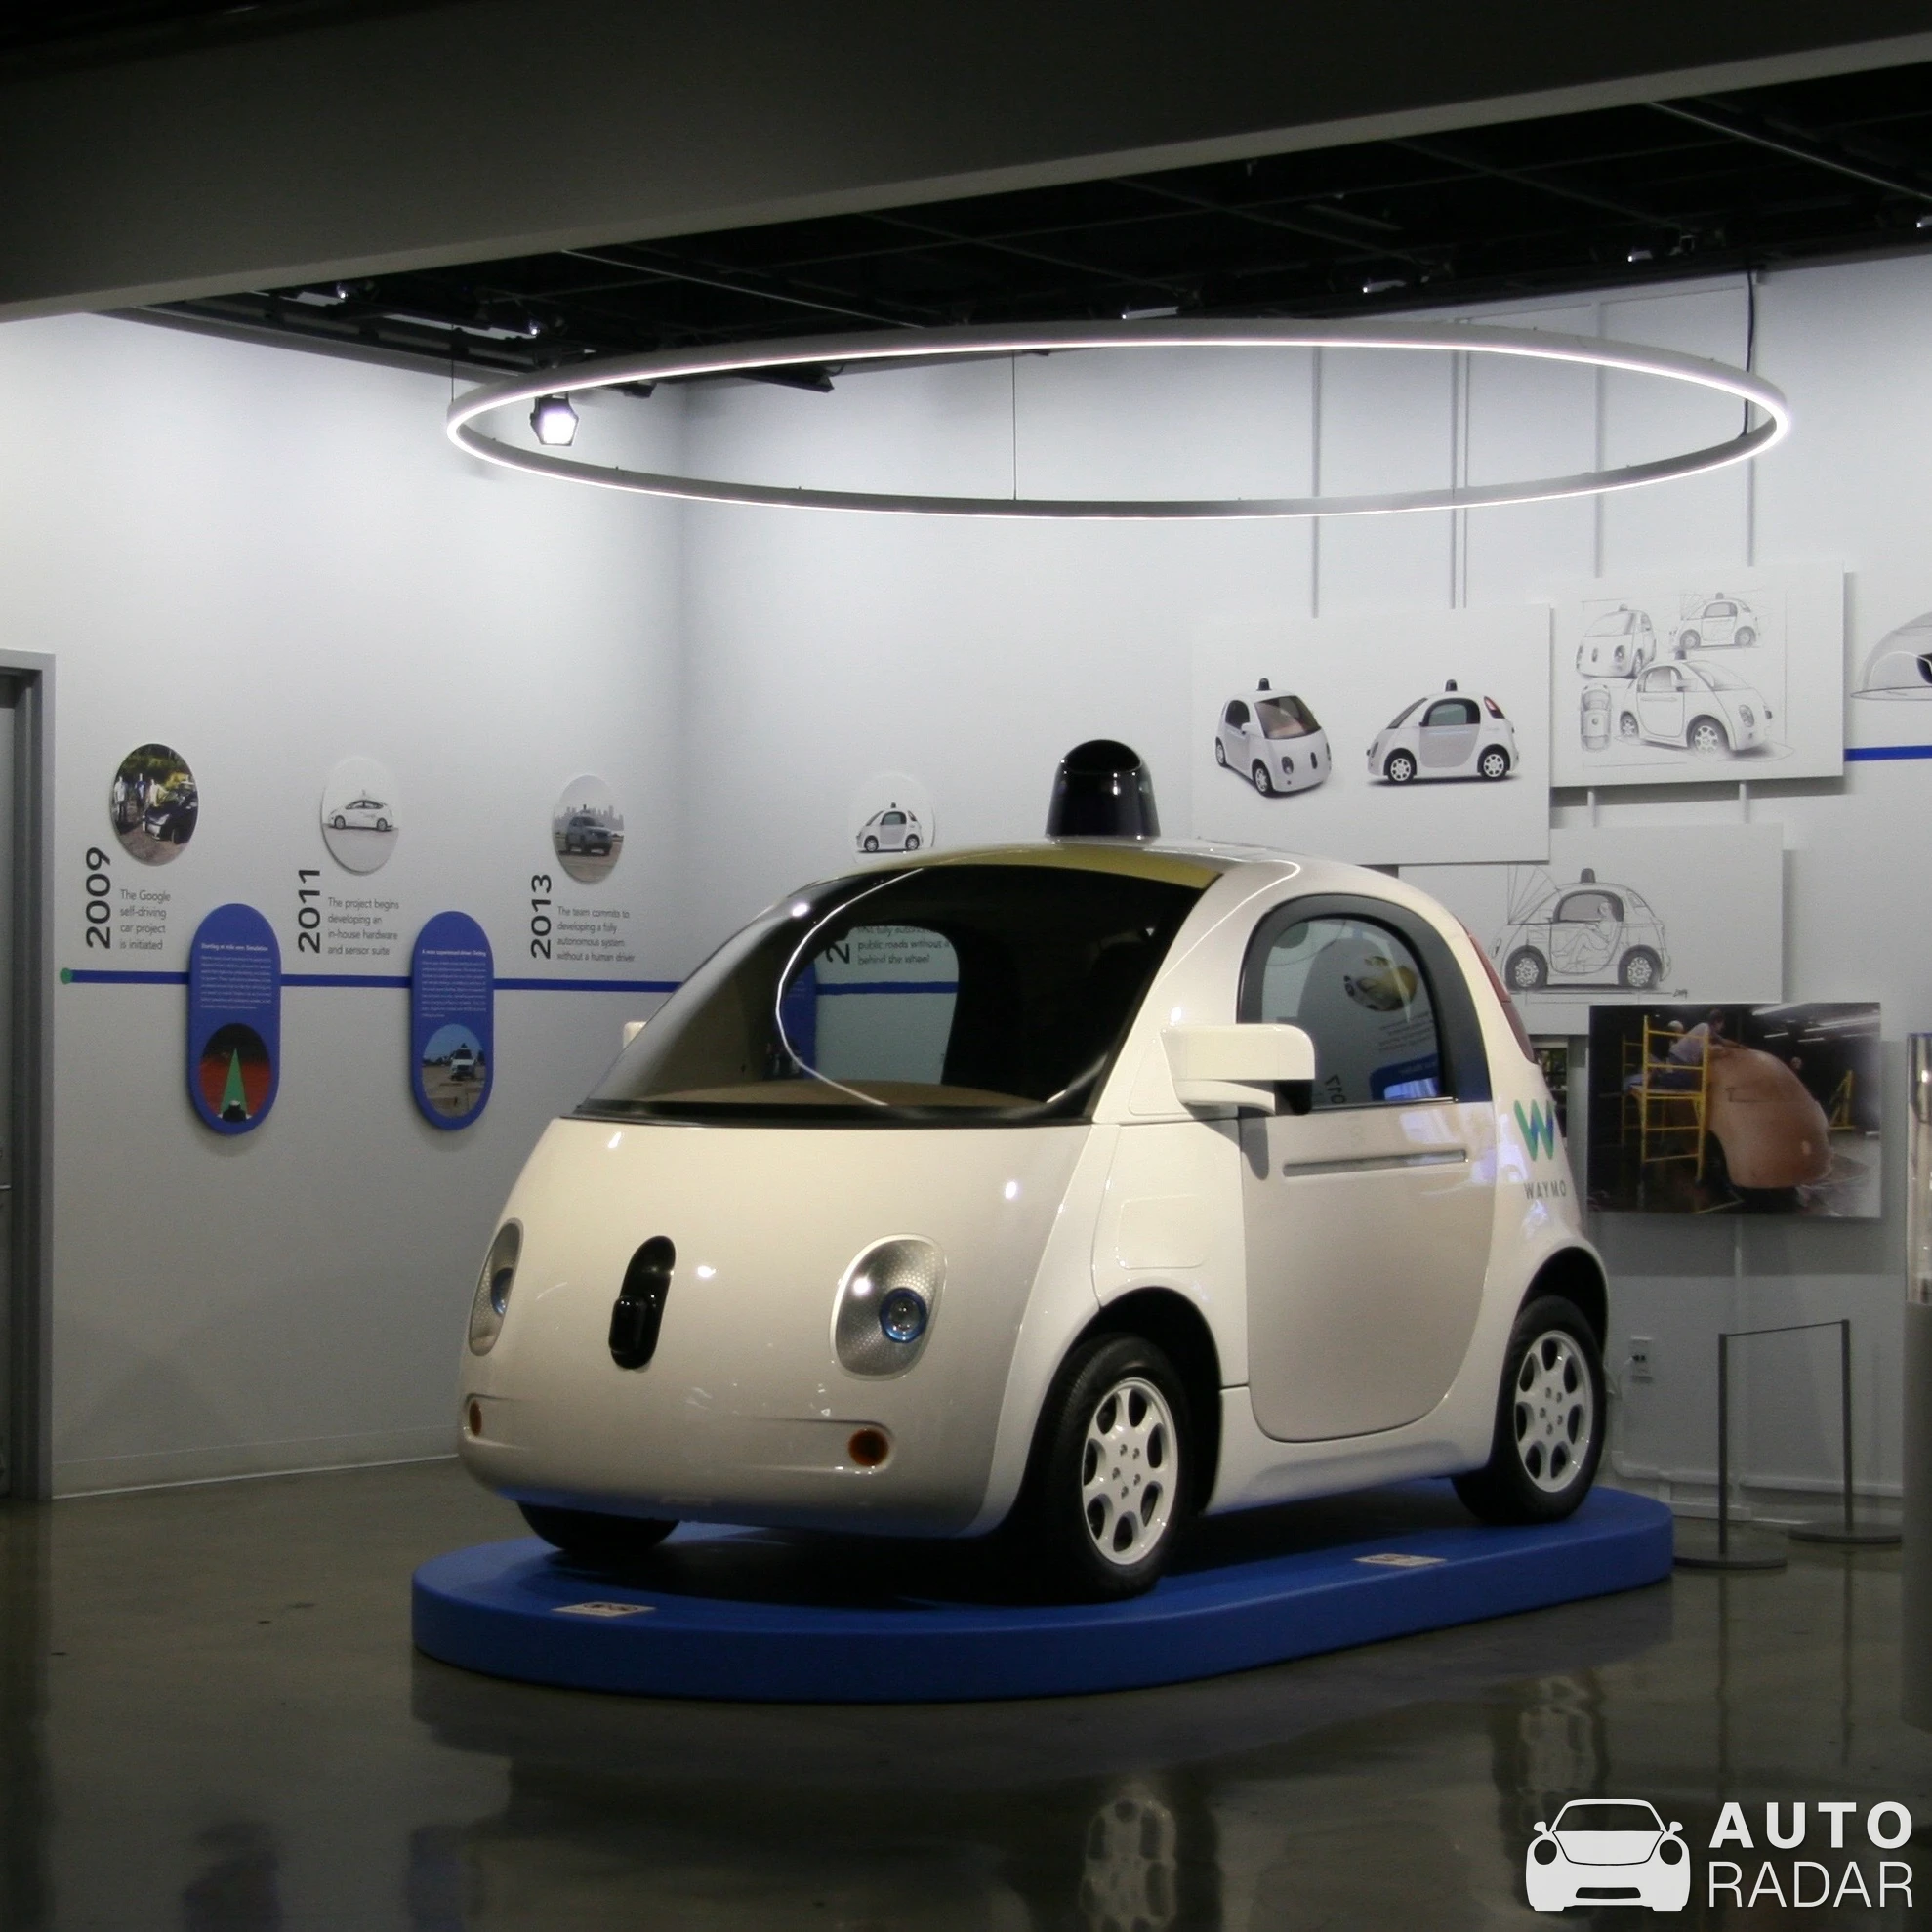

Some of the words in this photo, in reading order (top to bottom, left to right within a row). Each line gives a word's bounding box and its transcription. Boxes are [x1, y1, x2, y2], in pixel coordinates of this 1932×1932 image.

[85, 847, 111, 949] 2009
[120, 888, 137, 901] The
[139, 889, 171, 904] Google
[328, 896, 343, 908] The
[345, 898, 372, 911] project
[374, 898, 400, 912] begins
[120, 902, 167, 921] self-driving
[298, 869, 321, 954] 2011
[530, 874, 552, 960] 2013
[557, 905, 571, 916] The
[572, 907, 591, 917] team
[592, 908, 621, 919] commits
[622, 909, 631, 919] to
[328, 913, 371, 926] developing
[372, 916, 383, 925] an
[120, 925, 134, 933] car
[136, 922, 166, 936] project
[328, 926, 361, 939] in-house
[362, 928, 398, 940] hardware
[557, 920, 596, 934] developing
[603, 922, 618, 934] fully
[119, 938, 127, 950] is
[129, 937, 164, 951] initiated
[327, 942, 343, 955] and
[345, 946, 370, 955] sensor
[372, 944, 391, 956] suite
[556, 935, 600, 946] autonomous
[601, 938, 626, 949] system
[556, 949, 583, 961] without
[591, 951, 614, 962] human
[615, 951, 637, 963] driver
[1524, 1179, 1567, 1200] WAYMO
